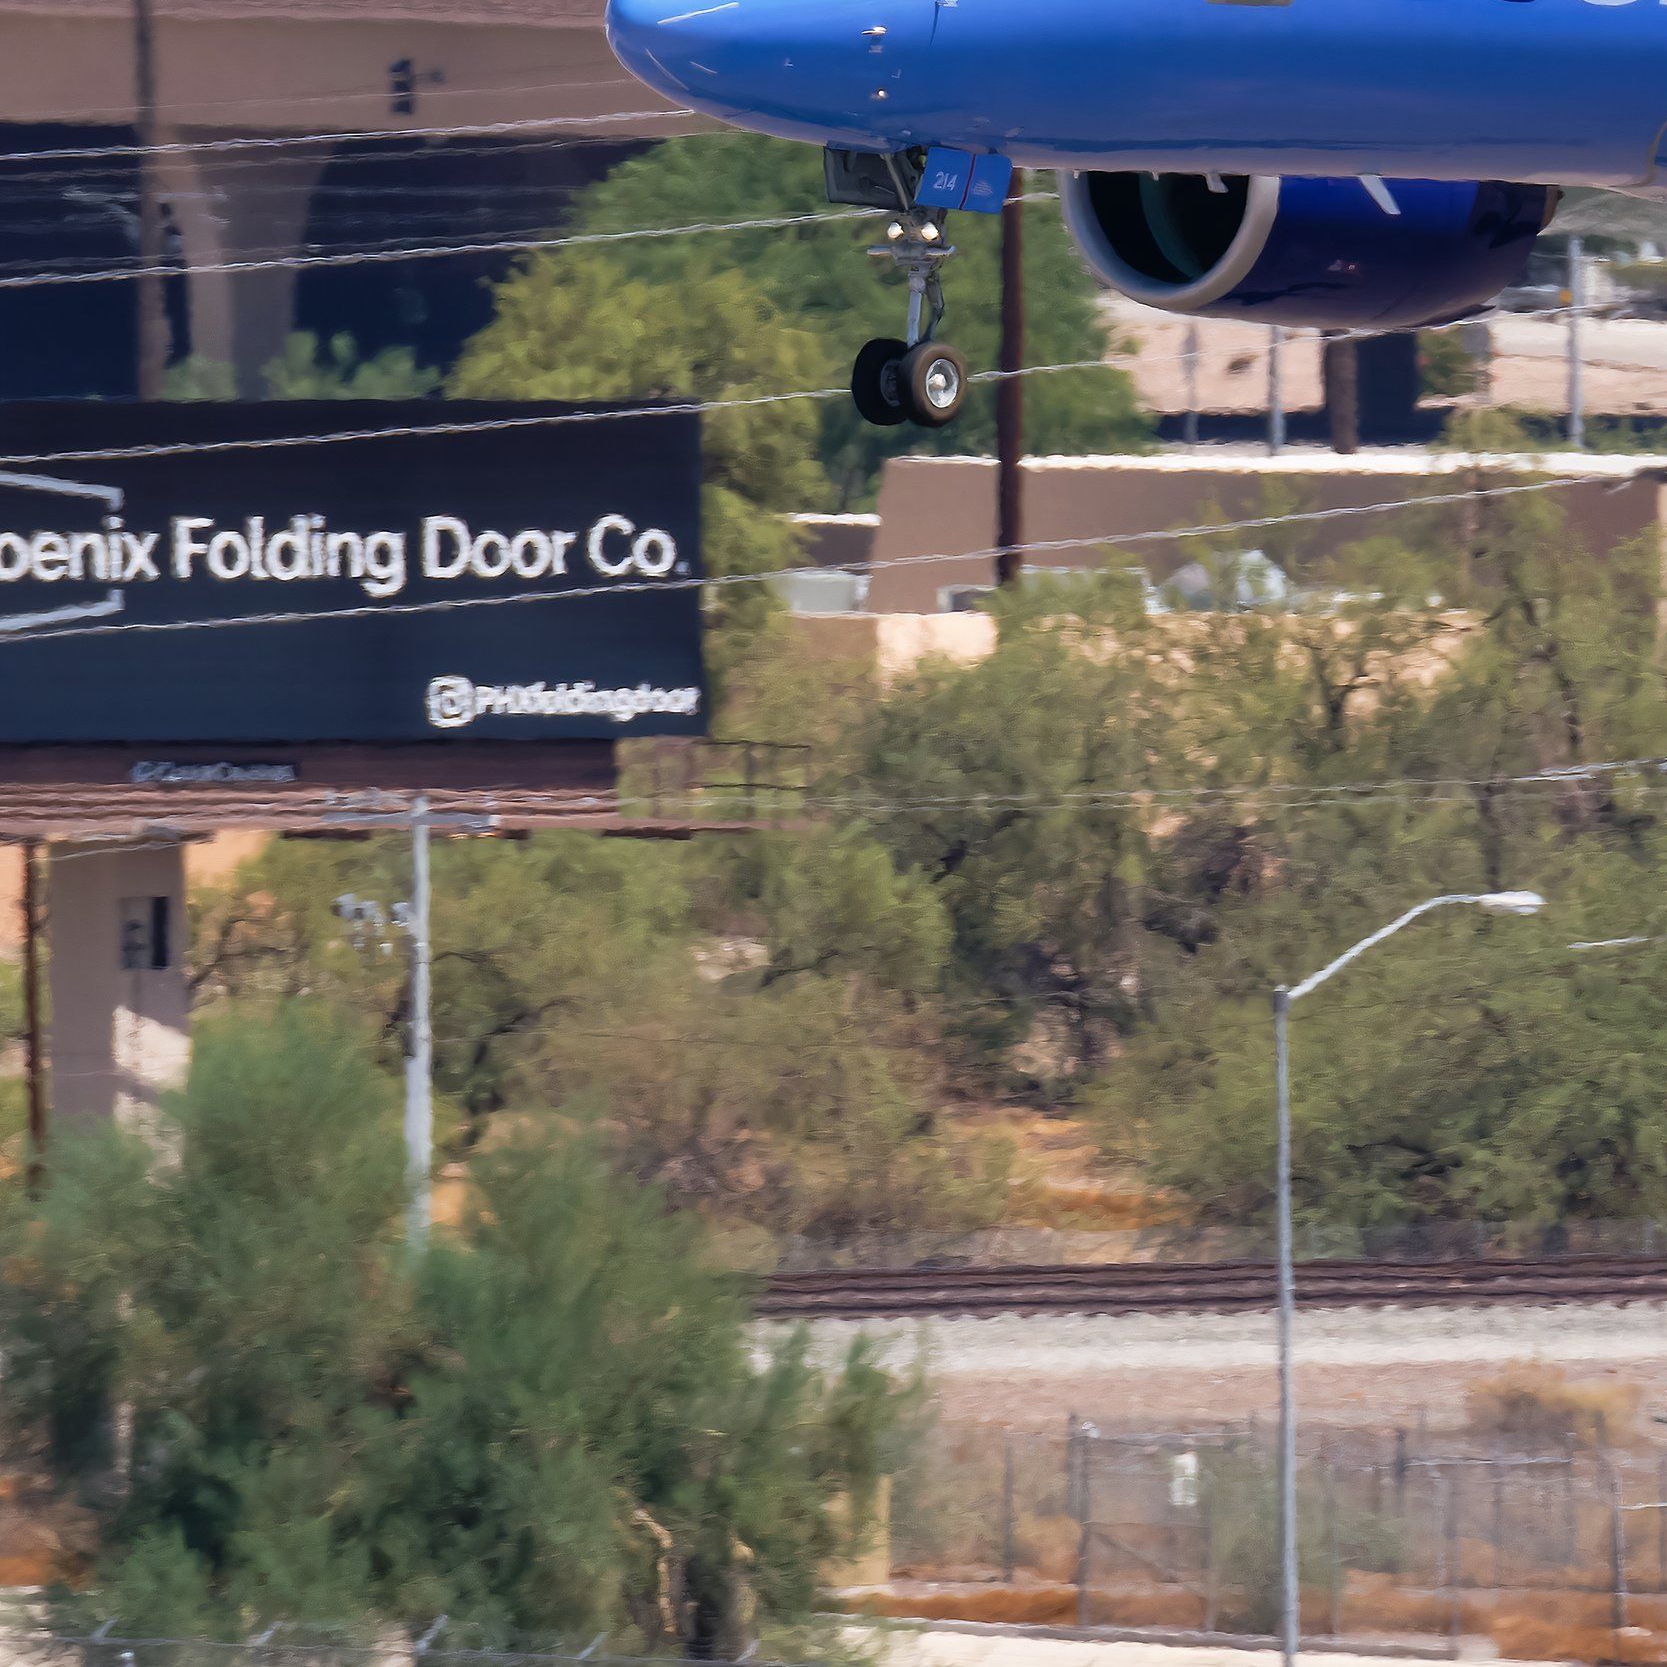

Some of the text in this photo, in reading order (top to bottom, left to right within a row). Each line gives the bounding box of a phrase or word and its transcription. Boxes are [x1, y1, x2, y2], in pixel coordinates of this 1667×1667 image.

[932, 170, 958, 192] 214
[172, 513, 407, 598] Folding
[421, 514, 578, 579] Door
[587, 512, 692, 578] Co.
